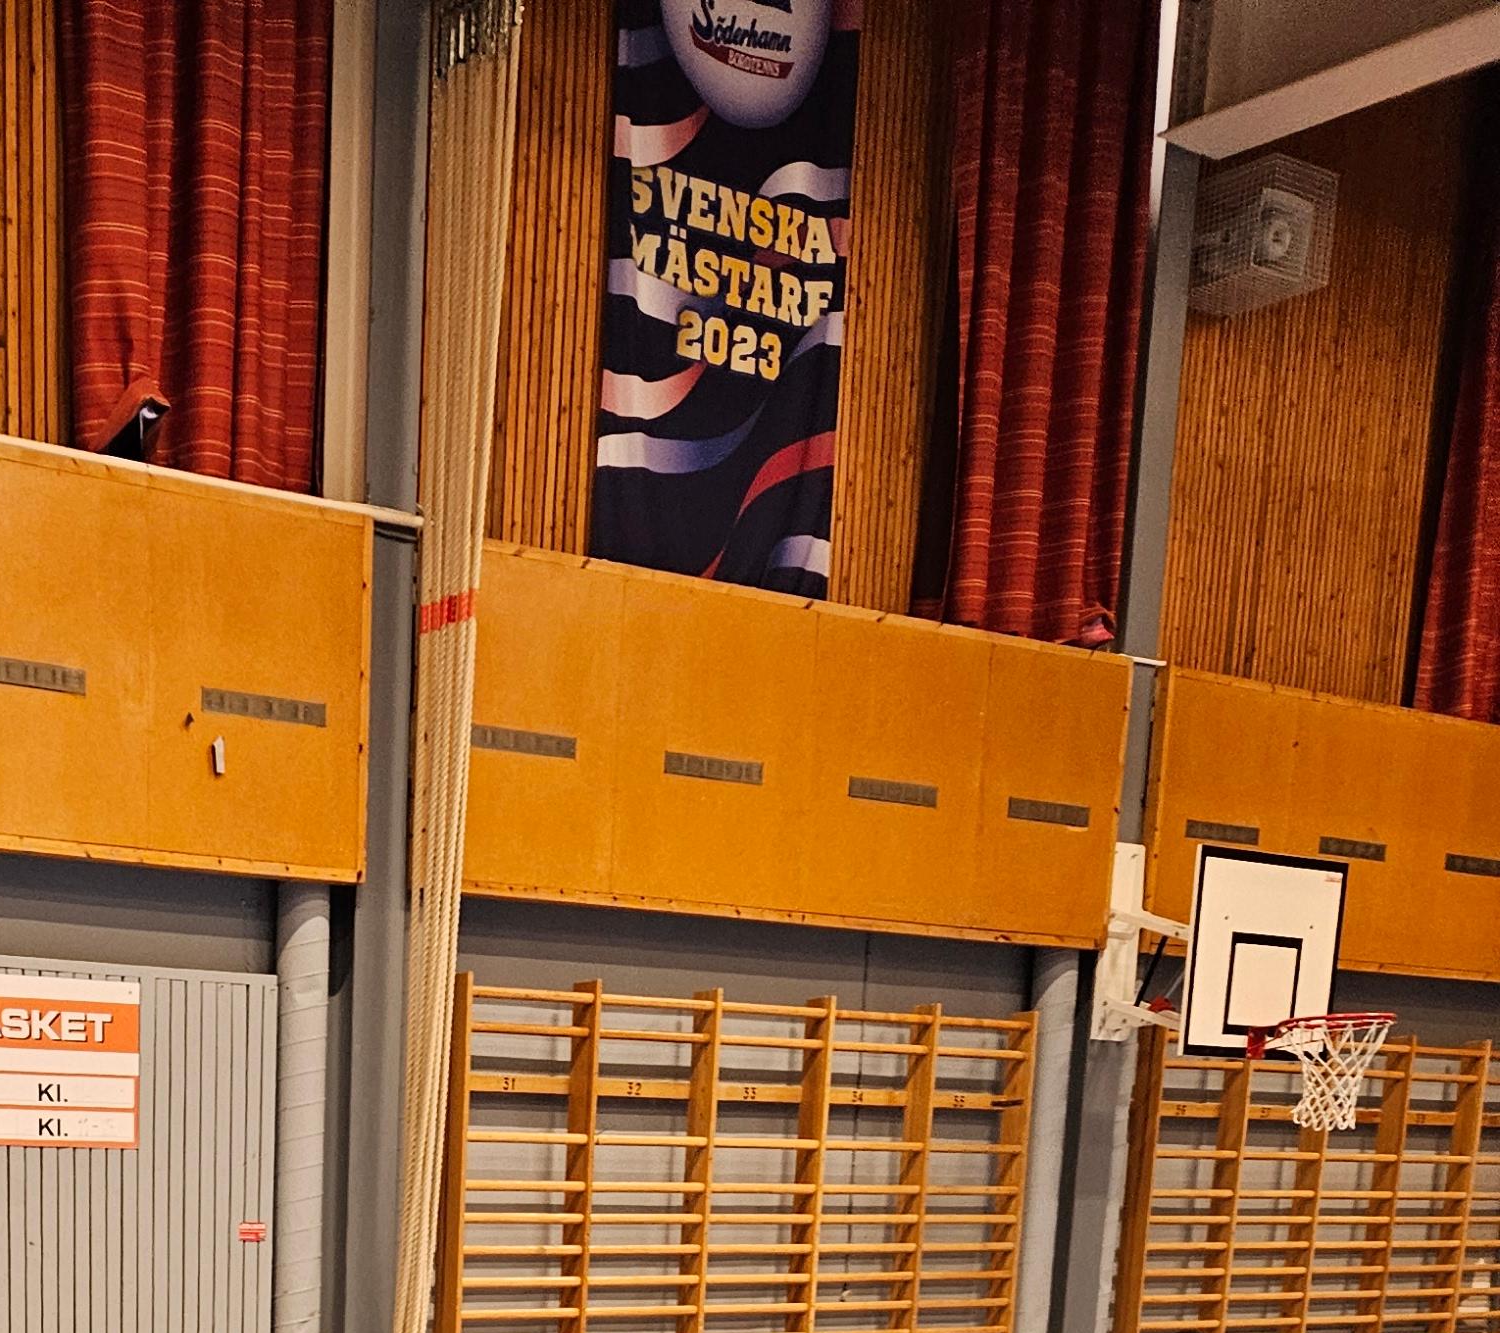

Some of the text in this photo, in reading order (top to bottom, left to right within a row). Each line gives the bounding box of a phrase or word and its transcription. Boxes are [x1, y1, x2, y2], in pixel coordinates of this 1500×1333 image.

[631, 166, 837, 264] SVENSKA
[676, 309, 782, 382] 2023
[37, 1083, 70, 1103] Kl.
[37, 1118, 70, 1138] Kl.
